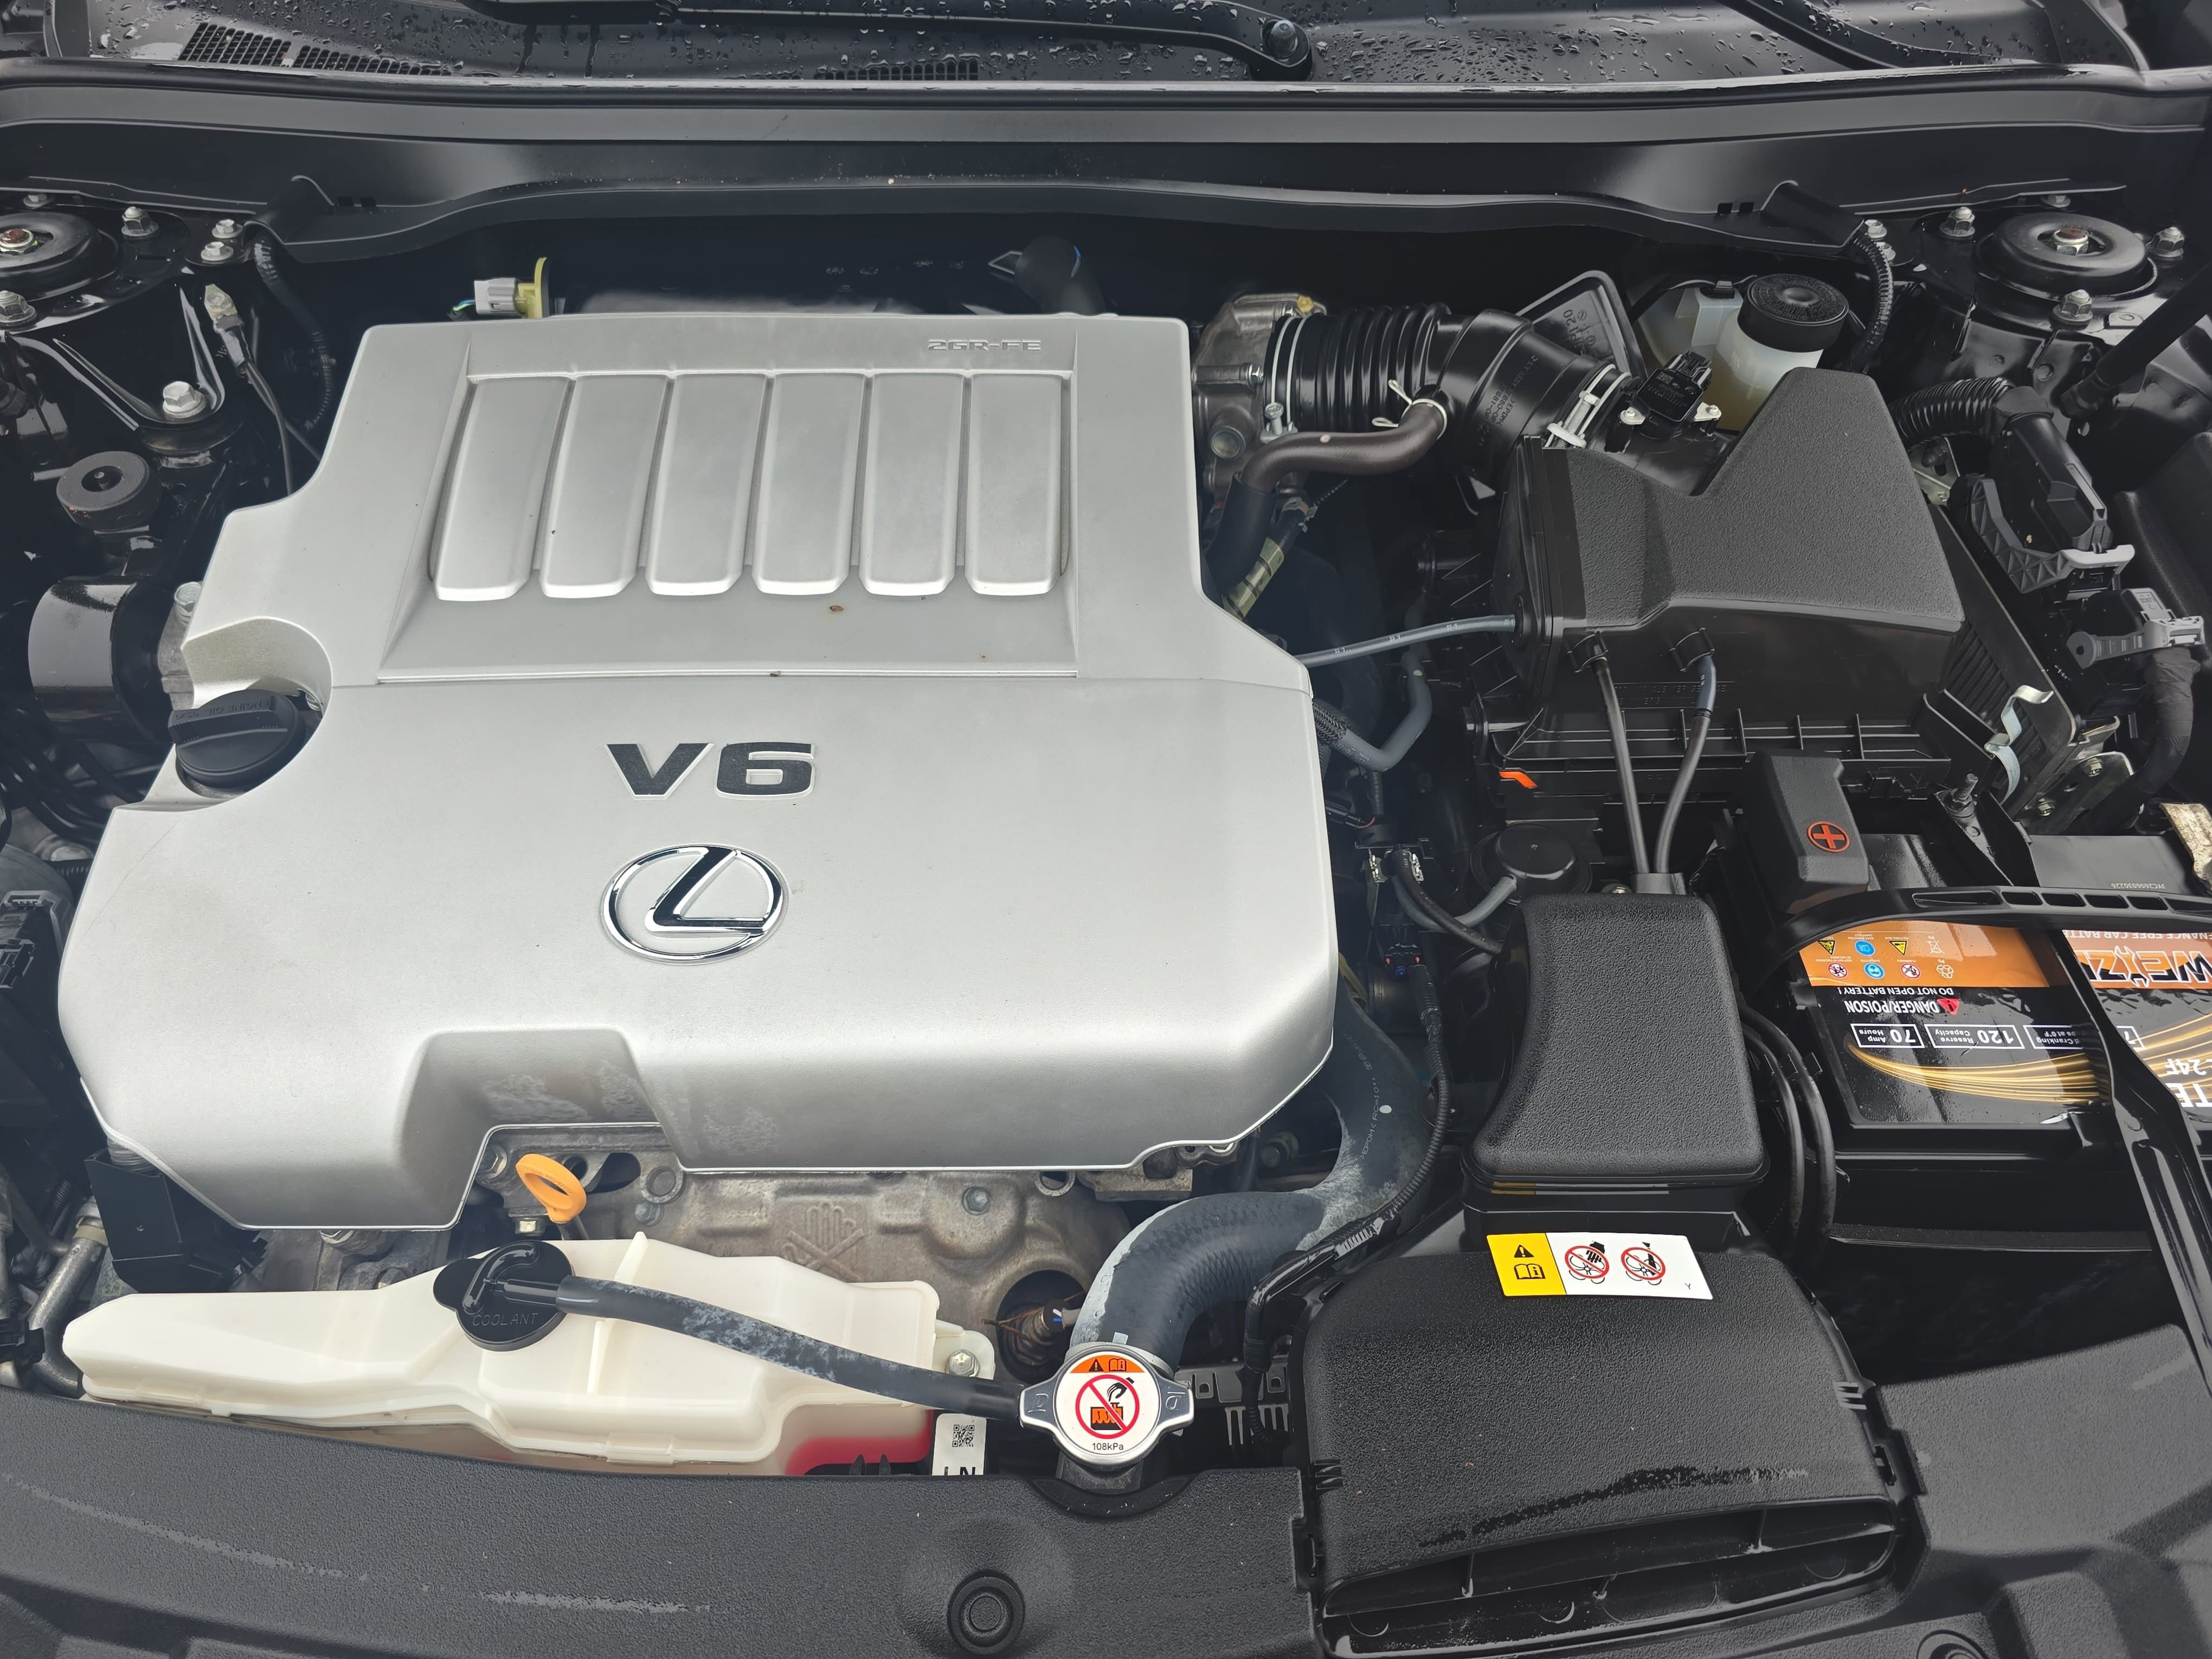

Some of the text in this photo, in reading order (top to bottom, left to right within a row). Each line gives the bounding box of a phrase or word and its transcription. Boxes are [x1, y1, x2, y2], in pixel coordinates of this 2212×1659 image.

[928, 339, 1041, 351] 2GR-FE
[603, 742, 814, 800] V6
[1844, 1000, 1940, 1013] DANGER/POISON
[1890, 1029, 1916, 1043] 70
[1977, 1030, 2014, 1044] 120
[473, 1313, 538, 1326] COOLANT
[1092, 1443, 1124, 1451] 108kPa
